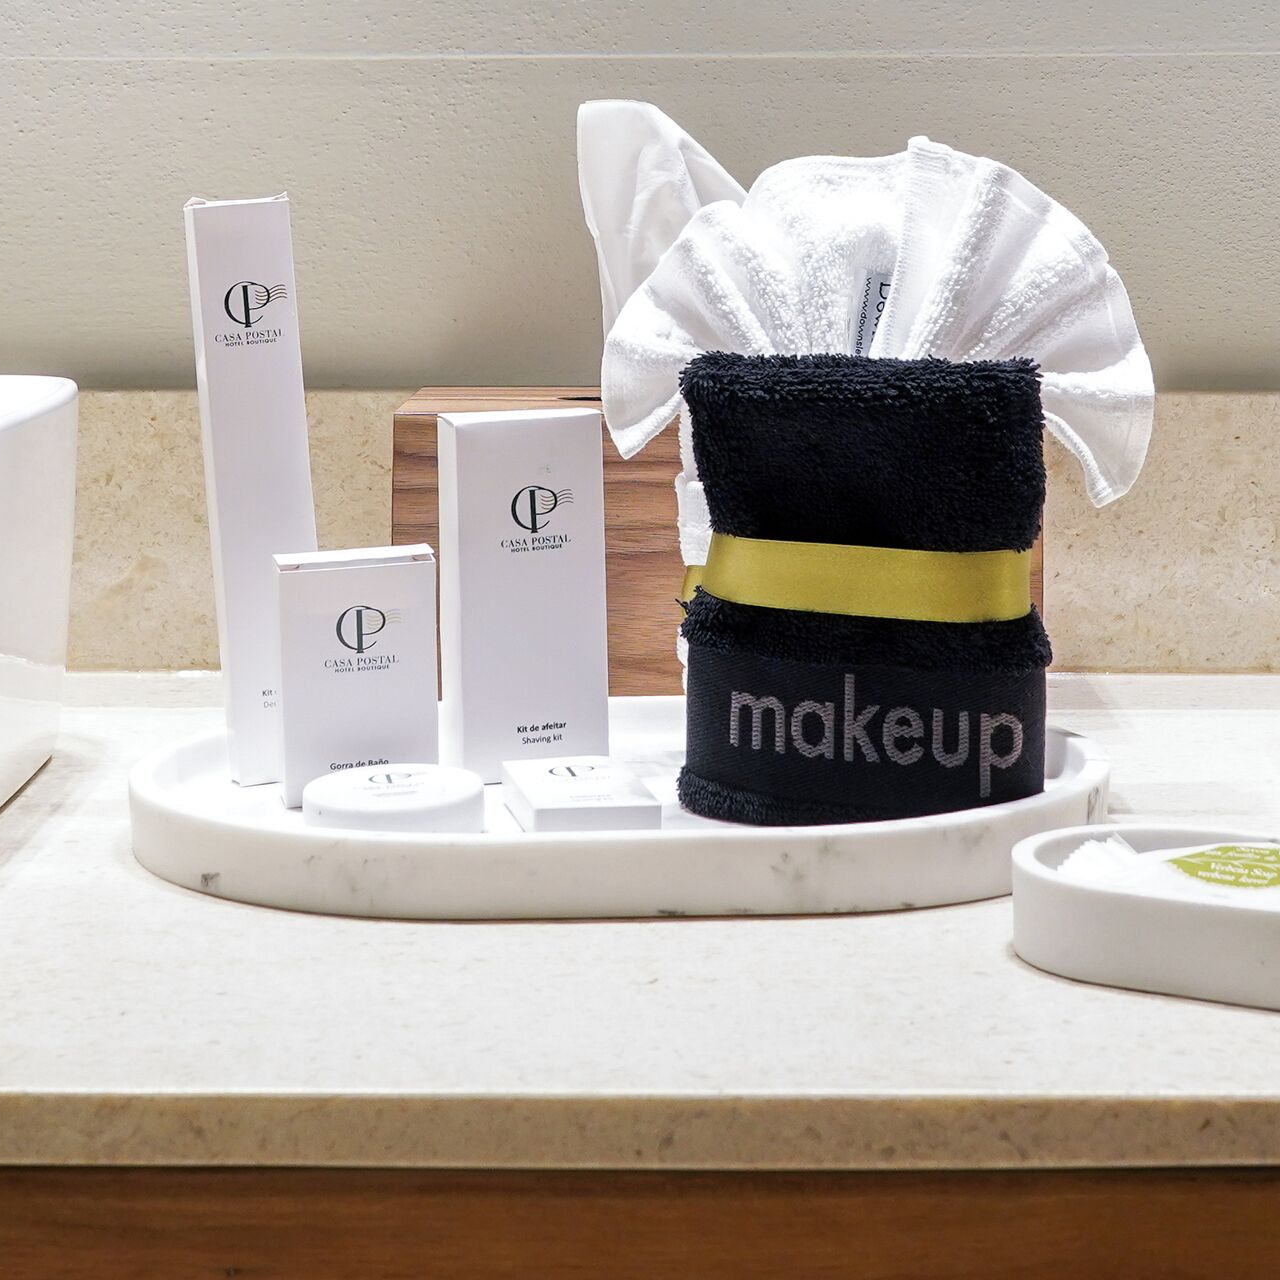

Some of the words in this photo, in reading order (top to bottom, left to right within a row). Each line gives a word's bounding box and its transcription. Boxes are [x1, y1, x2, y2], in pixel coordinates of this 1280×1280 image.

[215, 333, 241, 342] CASA
[246, 329, 285, 340] POSTAL
[500, 539, 528, 549] CASA
[531, 534, 572, 545] POSTAL
[324, 659, 353, 669] CASA
[356, 654, 400, 666] POSTAL
[357, 664, 390, 672] BOUTIQUE
[262, 689, 273, 697] Kit
[517, 726, 528, 734] Kit
[530, 724, 540, 732] de
[541, 721, 567, 731] afeitar
[522, 735, 552, 745] Shaving
[553, 733, 563, 741] kit
[728, 673, 1024, 798] makeup
[330, 762, 354, 771] Gorra
[355, 760, 366, 768] de
